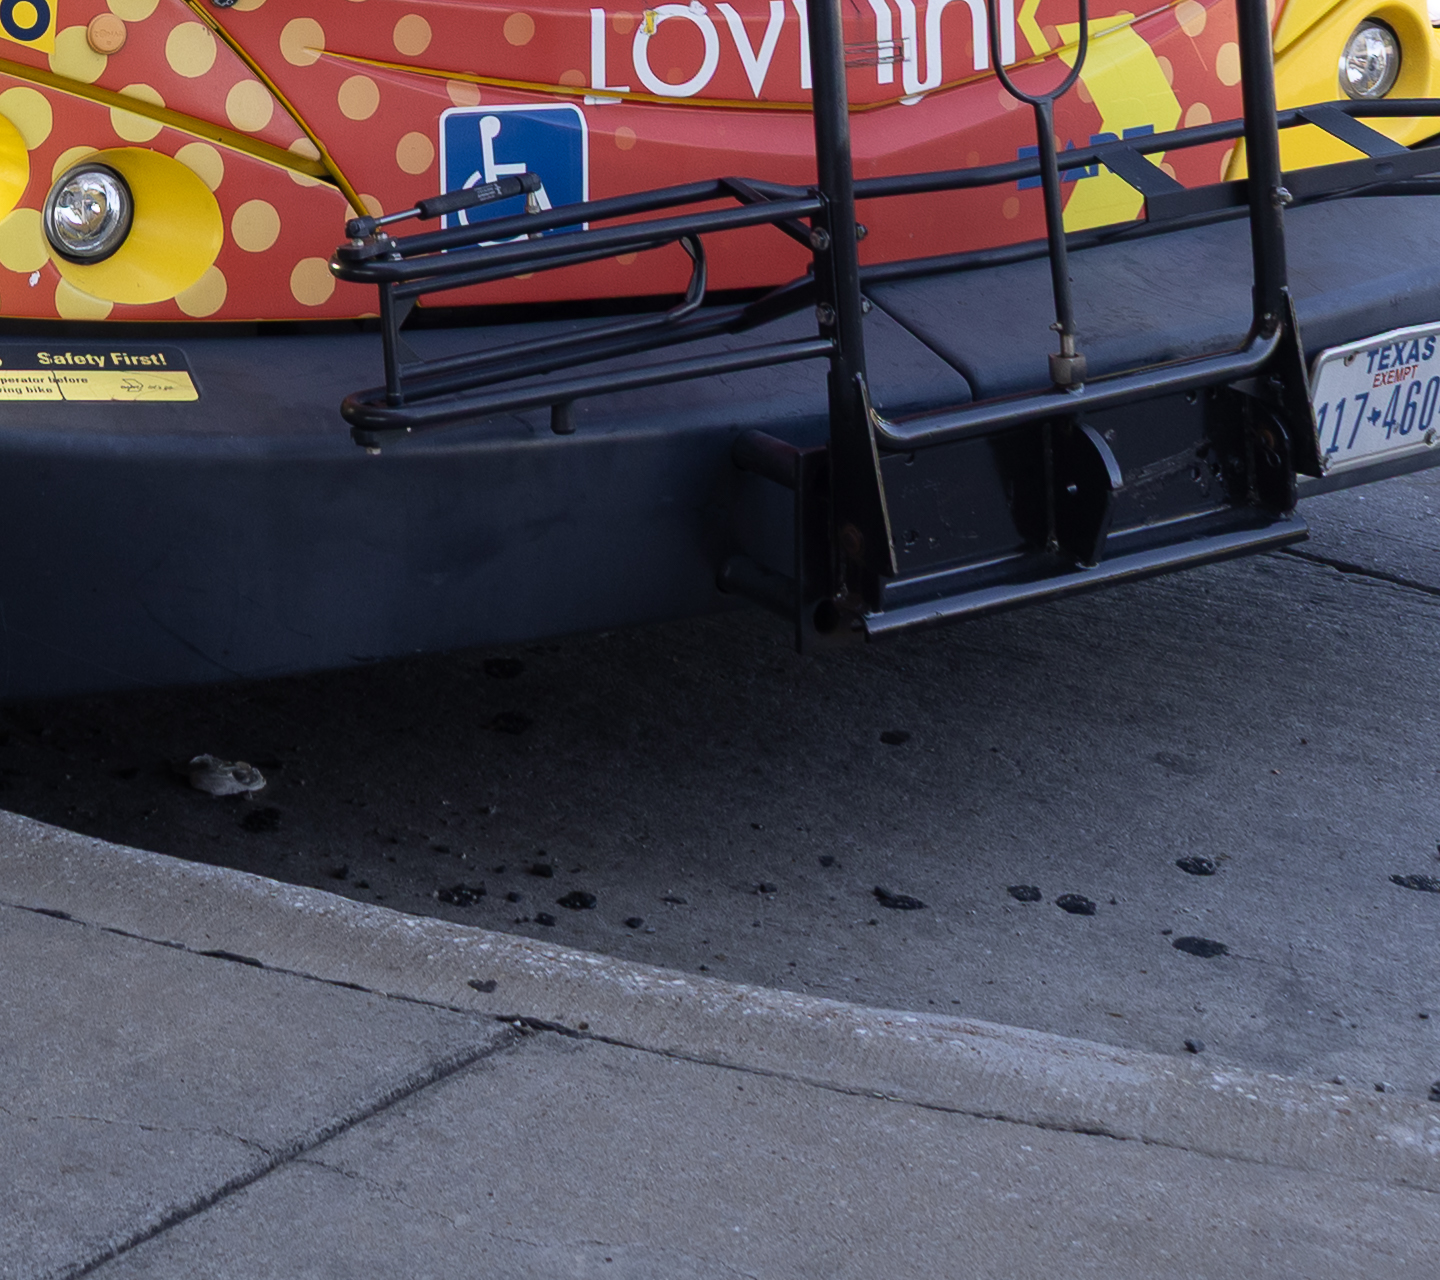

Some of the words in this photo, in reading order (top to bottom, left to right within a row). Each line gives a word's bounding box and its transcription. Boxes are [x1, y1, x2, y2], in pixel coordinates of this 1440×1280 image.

[36, 351, 105, 368] Safety
[110, 351, 167, 366] First!
[1366, 335, 1437, 375] TEXAS
[1372, 364, 1419, 388] EXEMPT
[26, 385, 53, 394] bike
